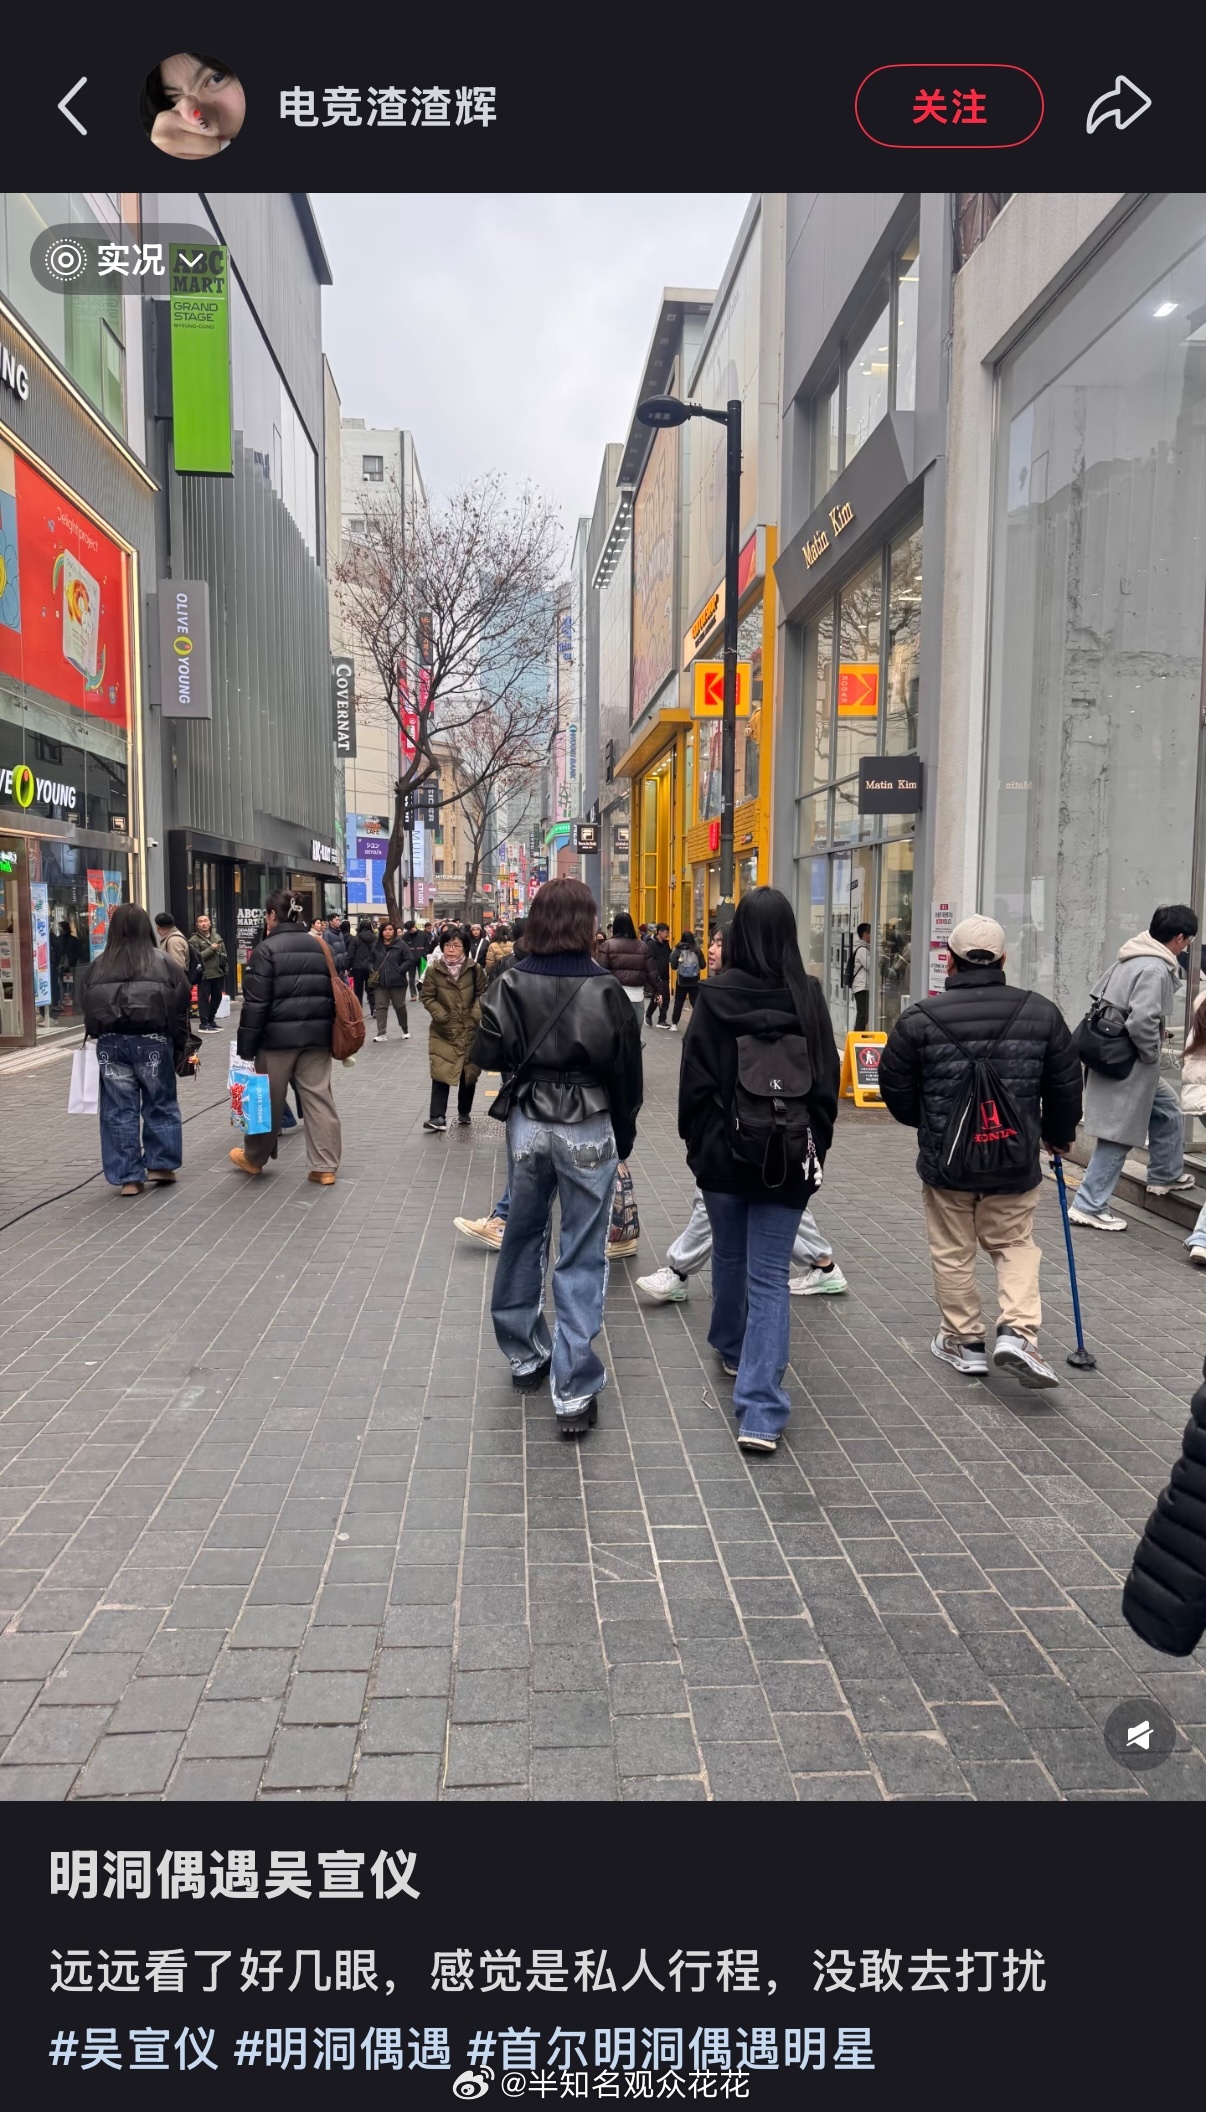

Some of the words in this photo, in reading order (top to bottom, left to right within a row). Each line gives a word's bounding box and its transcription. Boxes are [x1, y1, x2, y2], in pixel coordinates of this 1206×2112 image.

[173, 249, 224, 275] ABC
[173, 276, 225, 294] MART
[173, 302, 218, 312] GRAND
[174, 312, 214, 322] STAGE
[0, 342, 29, 401] NG
[802, 530, 829, 570] Matin
[828, 502, 854, 537] Kim
[176, 592, 189, 634] OLIVE
[177, 657, 191, 705] YOUNG
[335, 663, 352, 751] COVERNAT
[36, 777, 76, 809] YOUNG
[865, 780, 893, 790] Matin
[898, 779, 917, 790] Kim
[237, 918, 258, 926] MART
